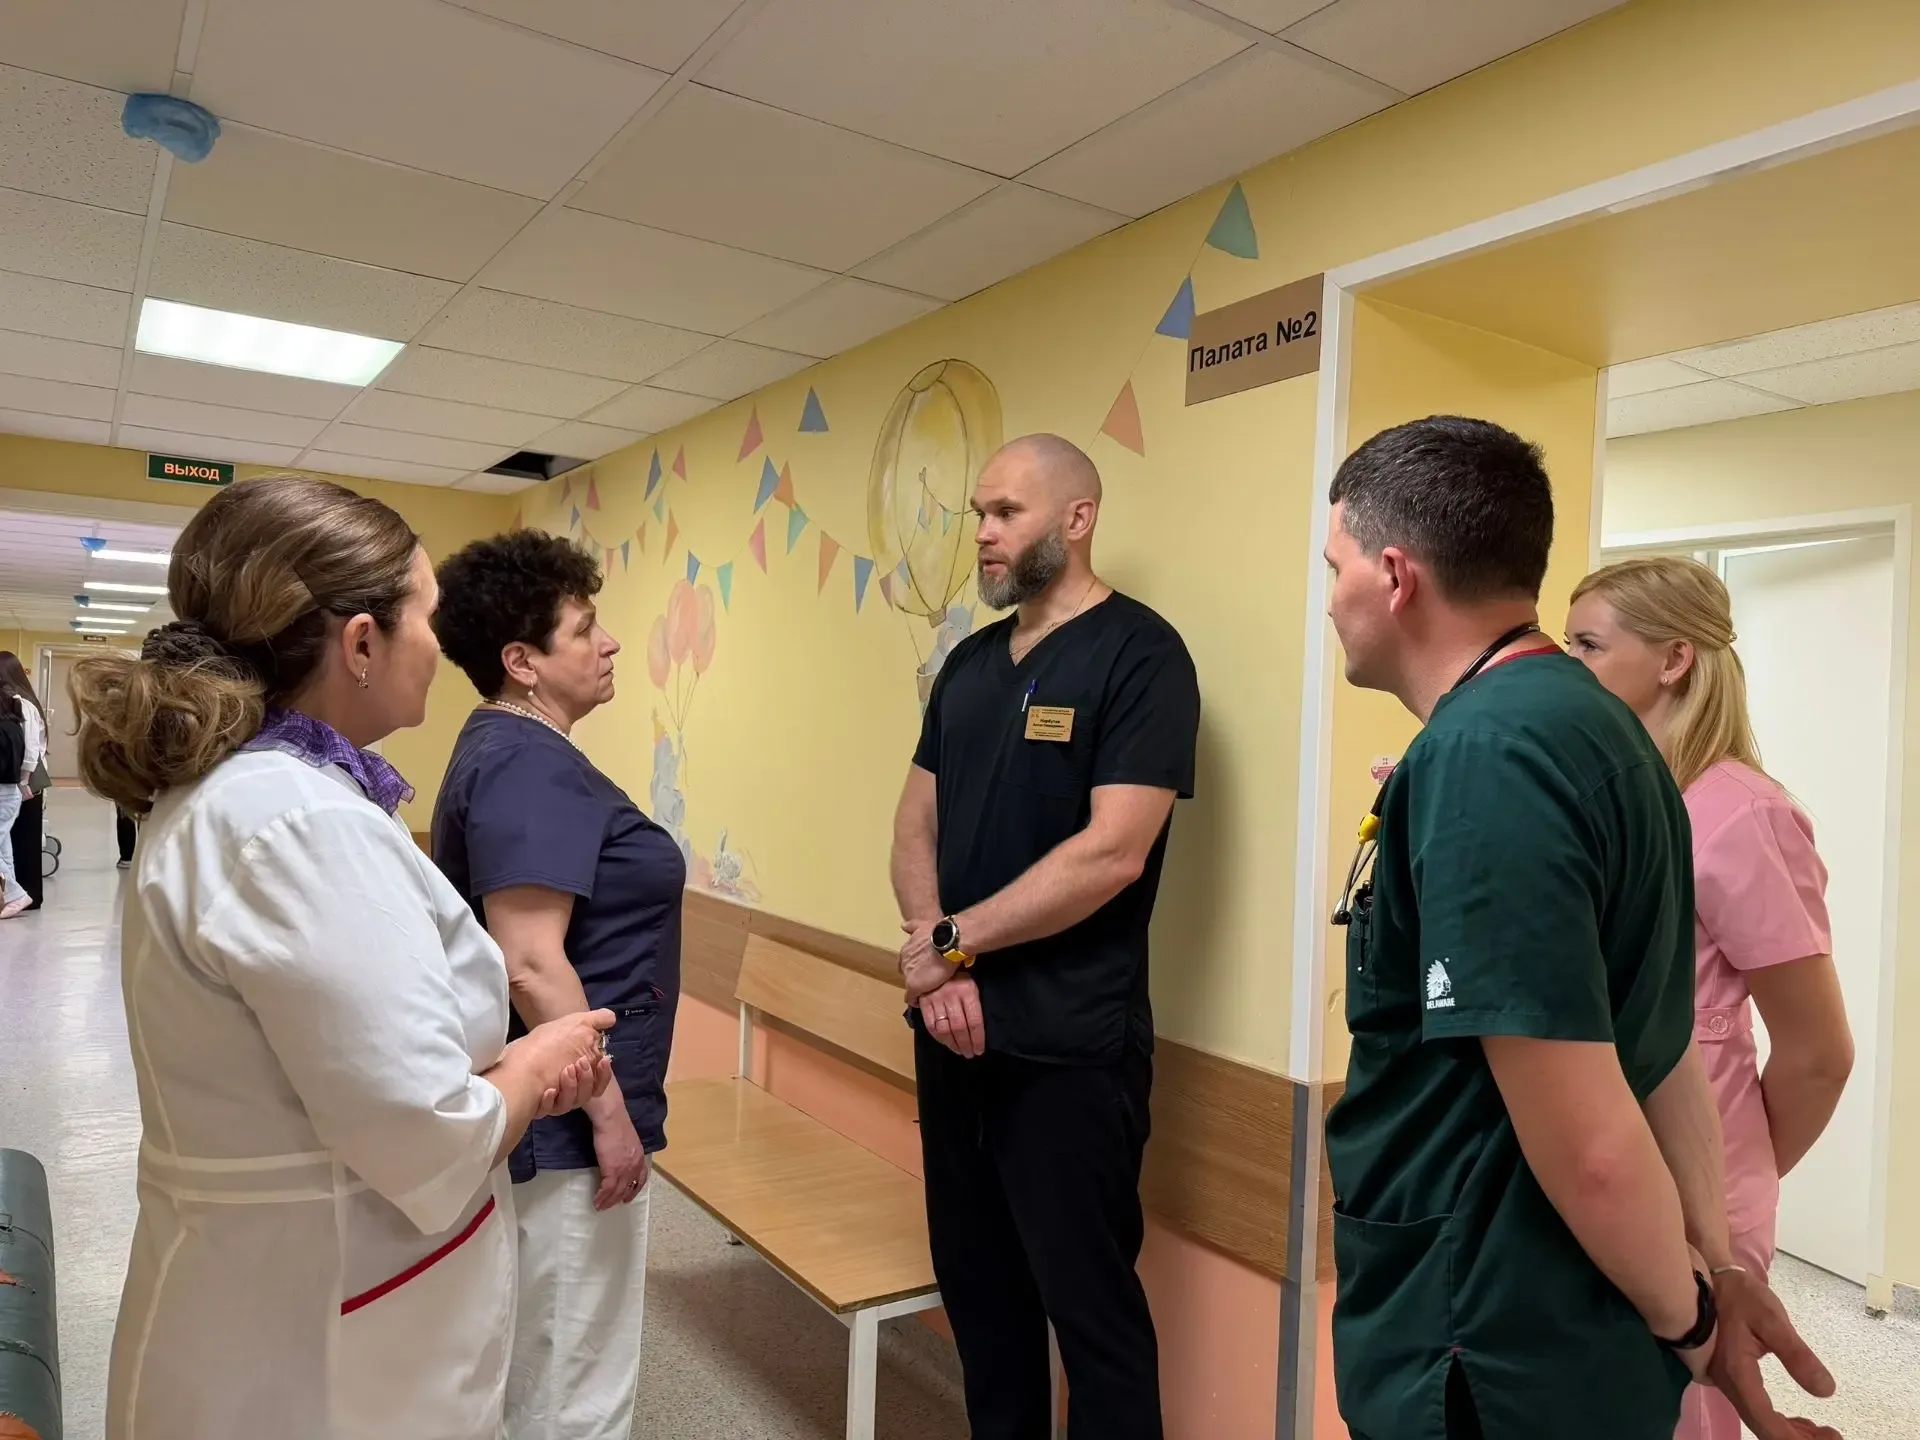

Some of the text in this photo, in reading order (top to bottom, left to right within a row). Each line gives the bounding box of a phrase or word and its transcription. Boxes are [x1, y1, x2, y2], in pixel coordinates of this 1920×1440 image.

[1190, 310, 1317, 373] Палата №2
[164, 462, 220, 482] ВЫХОД
[1426, 997, 1456, 1010] DELAWARE
